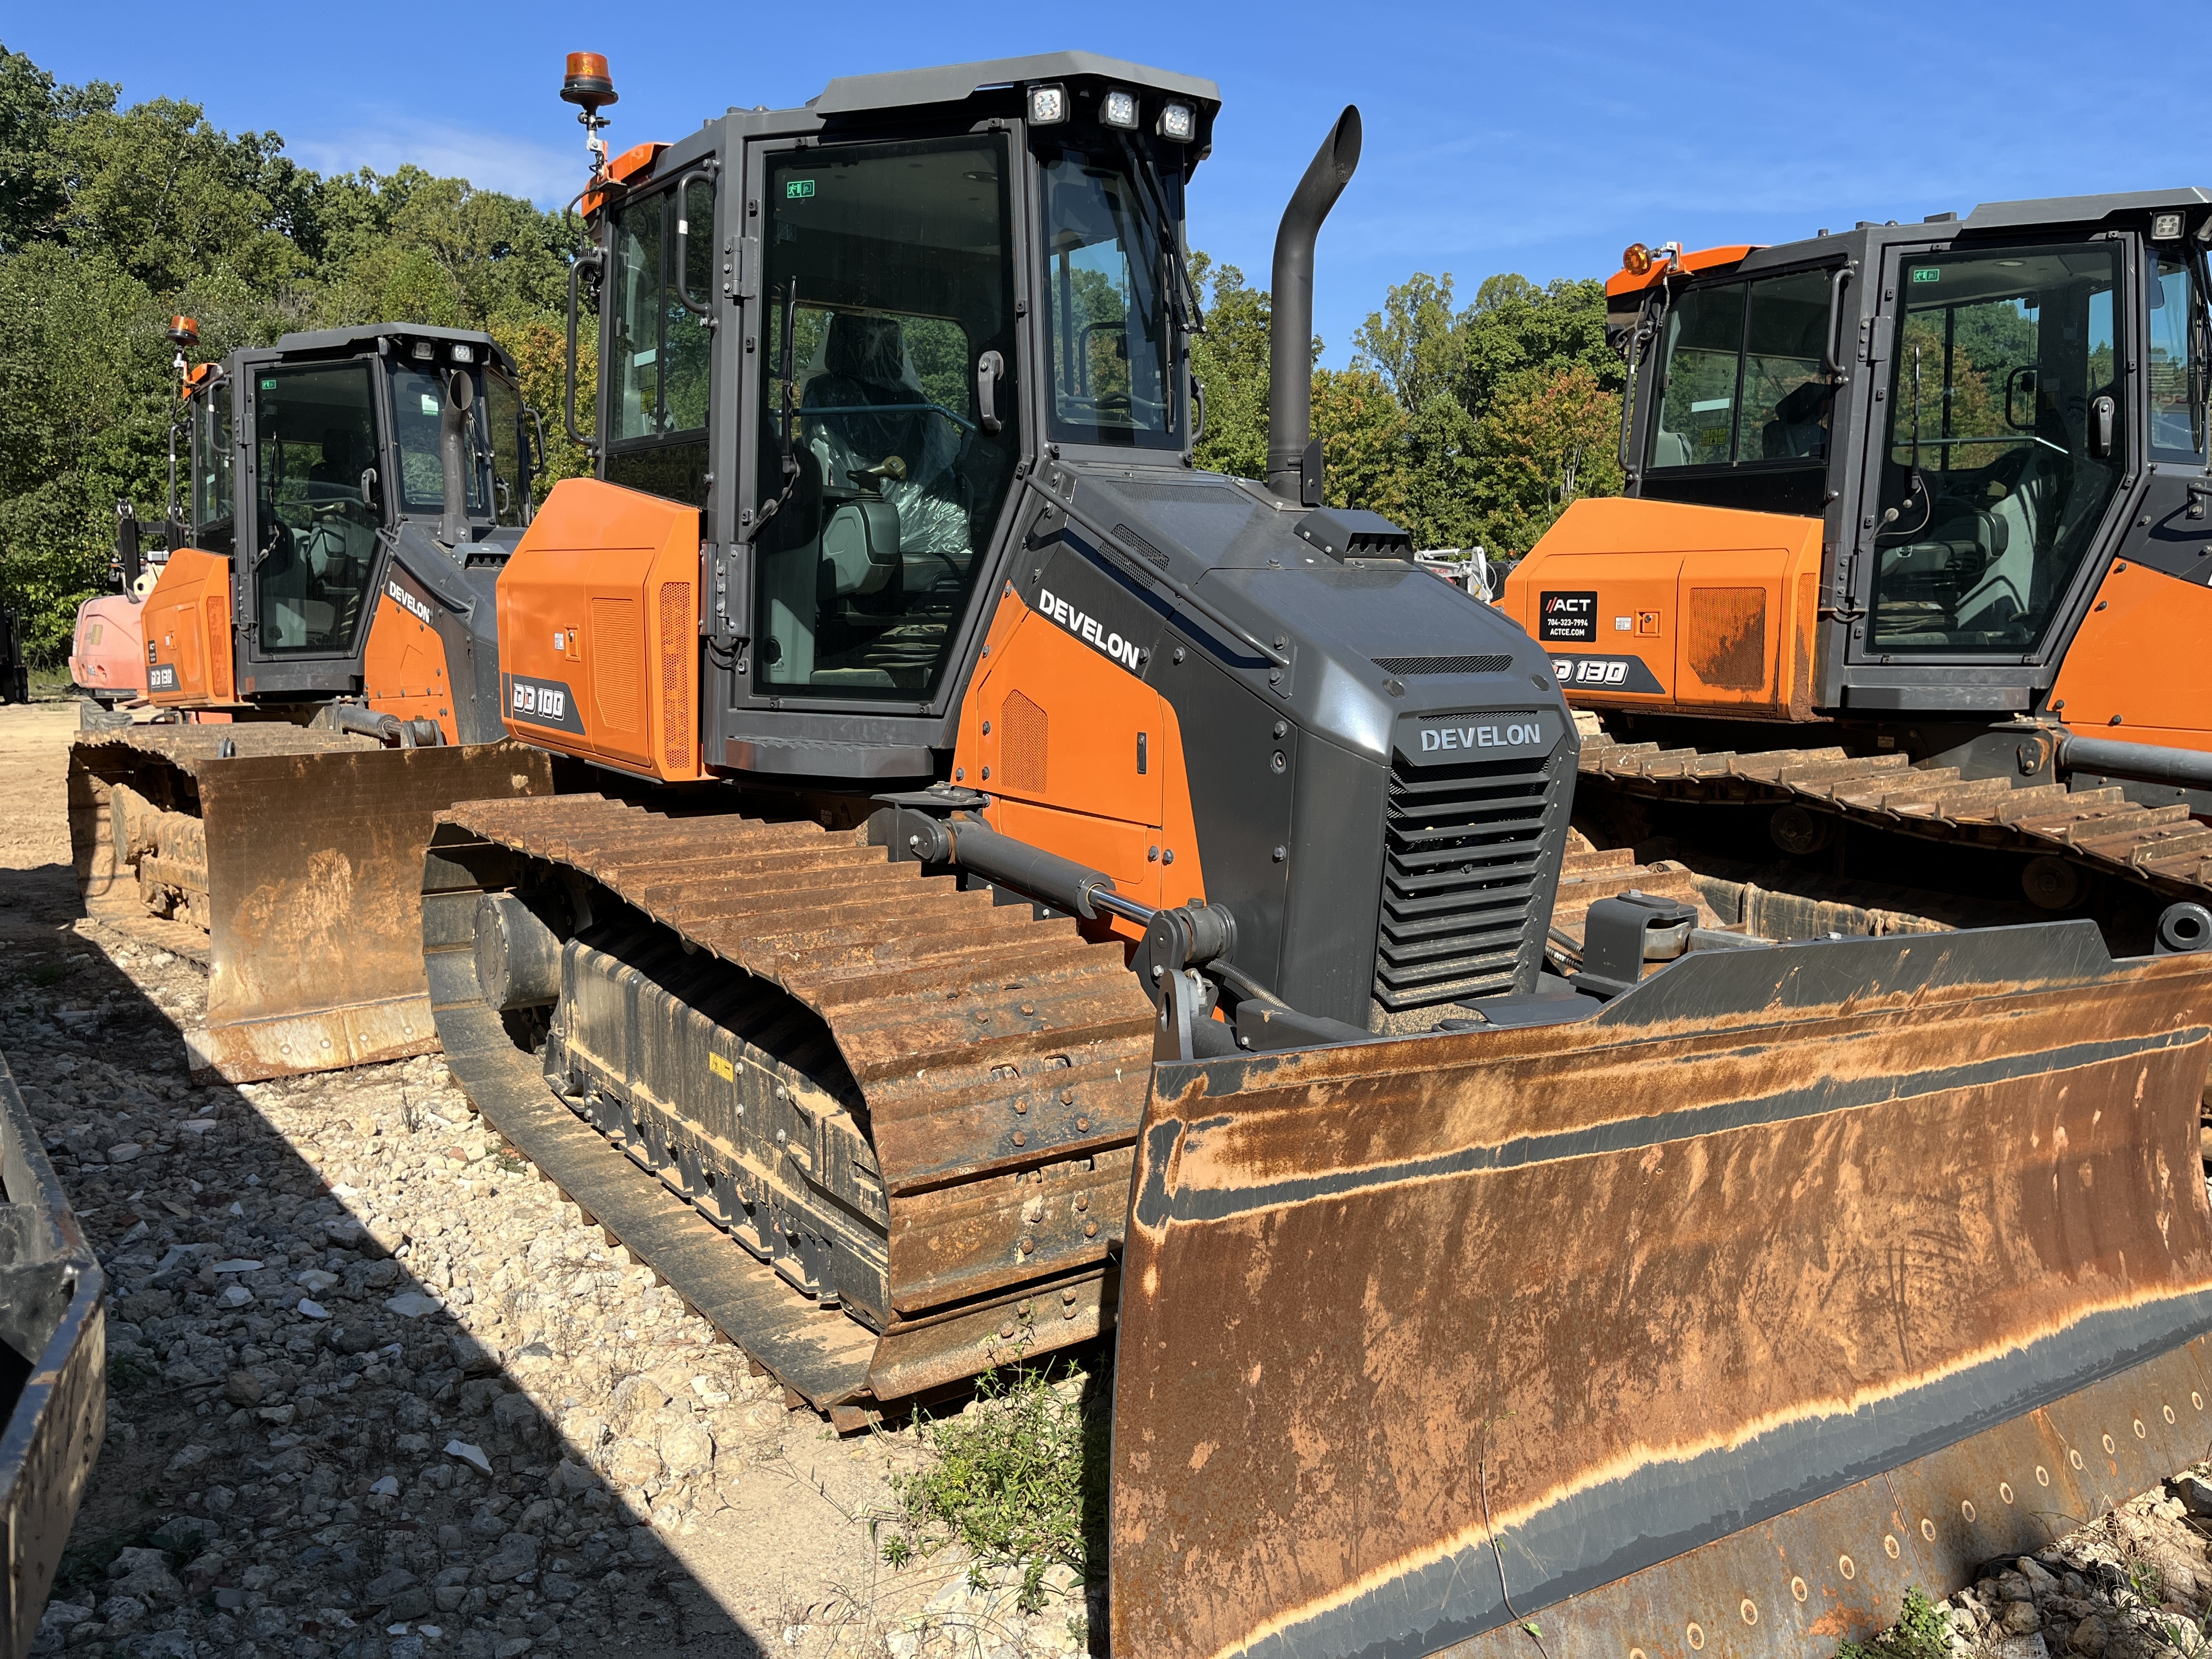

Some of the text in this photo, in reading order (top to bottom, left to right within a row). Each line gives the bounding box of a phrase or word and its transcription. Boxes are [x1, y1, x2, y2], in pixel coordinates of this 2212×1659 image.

[390, 580, 430, 624] DEVELON
[1039, 588, 1139, 670] DEVELON
[1547, 618, 1588, 627] 704-323-7994
[1550, 628, 1585, 636] ACTCE.COM
[1551, 660, 1629, 685] D 130
[514, 683, 566, 721] DD 100
[1421, 723, 1541, 752] DEVELON
